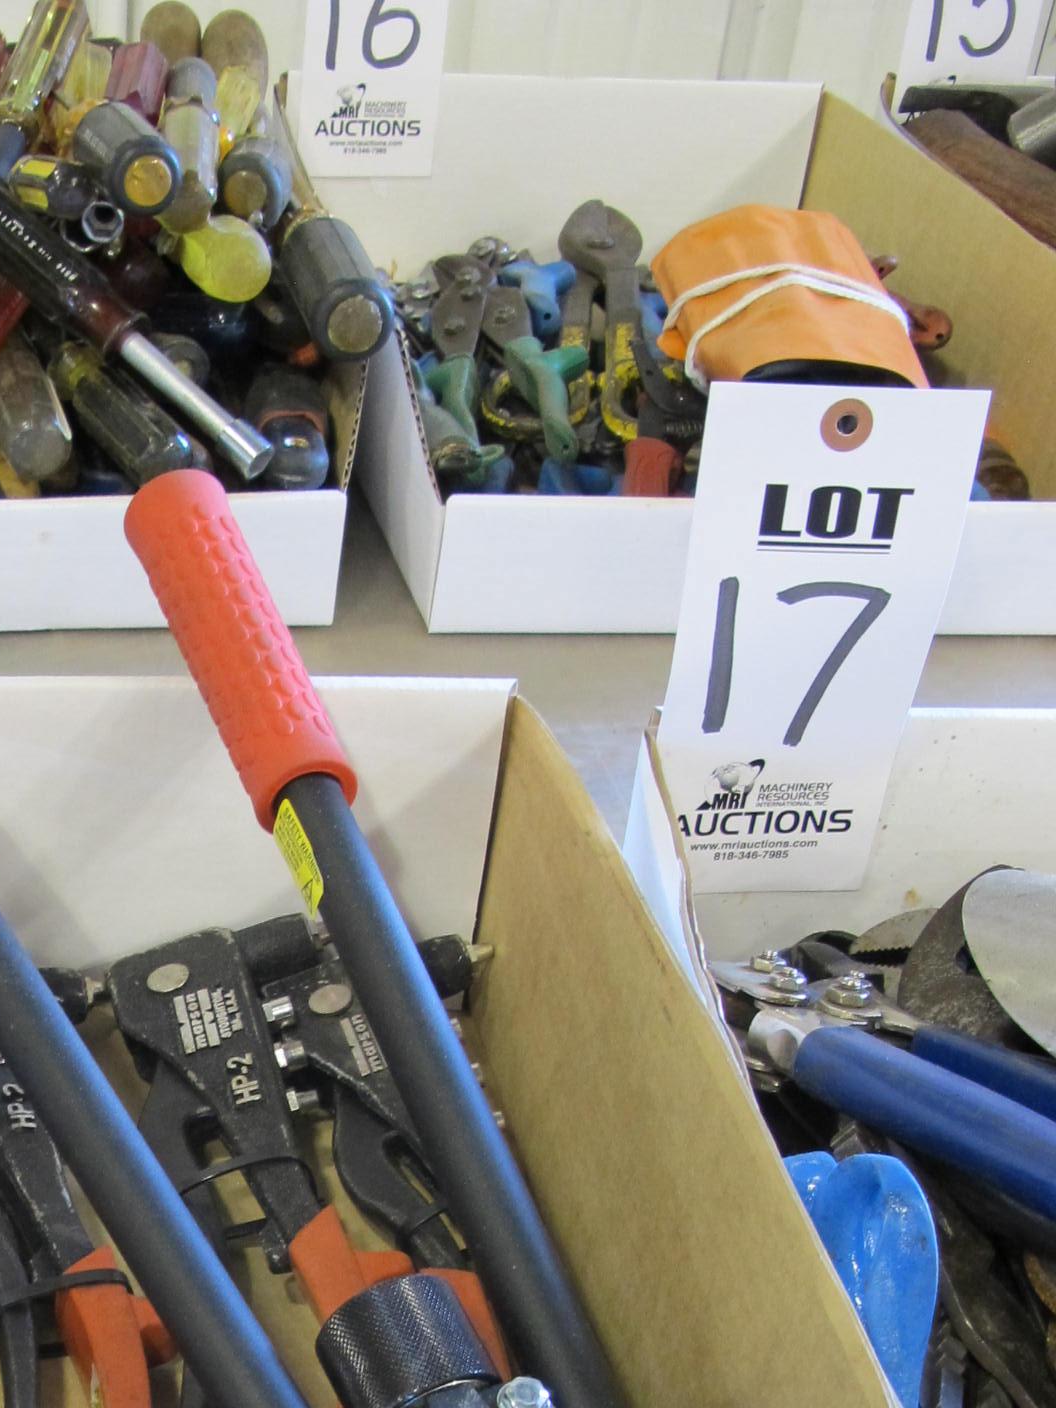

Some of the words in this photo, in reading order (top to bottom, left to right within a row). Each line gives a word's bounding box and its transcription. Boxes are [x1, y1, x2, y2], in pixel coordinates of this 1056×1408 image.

[325, 0, 421, 70] 16
[315, 120, 421, 137] AUCTIONS
[758, 483, 915, 540] LOT
[702, 576, 892, 747] 17
[711, 792, 749, 810] MRI
[757, 791, 829, 801] RESOURCES
[759, 782, 833, 793] MACHINERY
[678, 809, 853, 837] AUCTIONS
[690, 840, 818, 851] www.mriauctions.com
[713, 851, 789, 861] 818-346-7985
[186, 994, 208, 1049] marson
[351, 1013, 384, 1073] marson
[227, 1052, 262, 1105] HP-2
